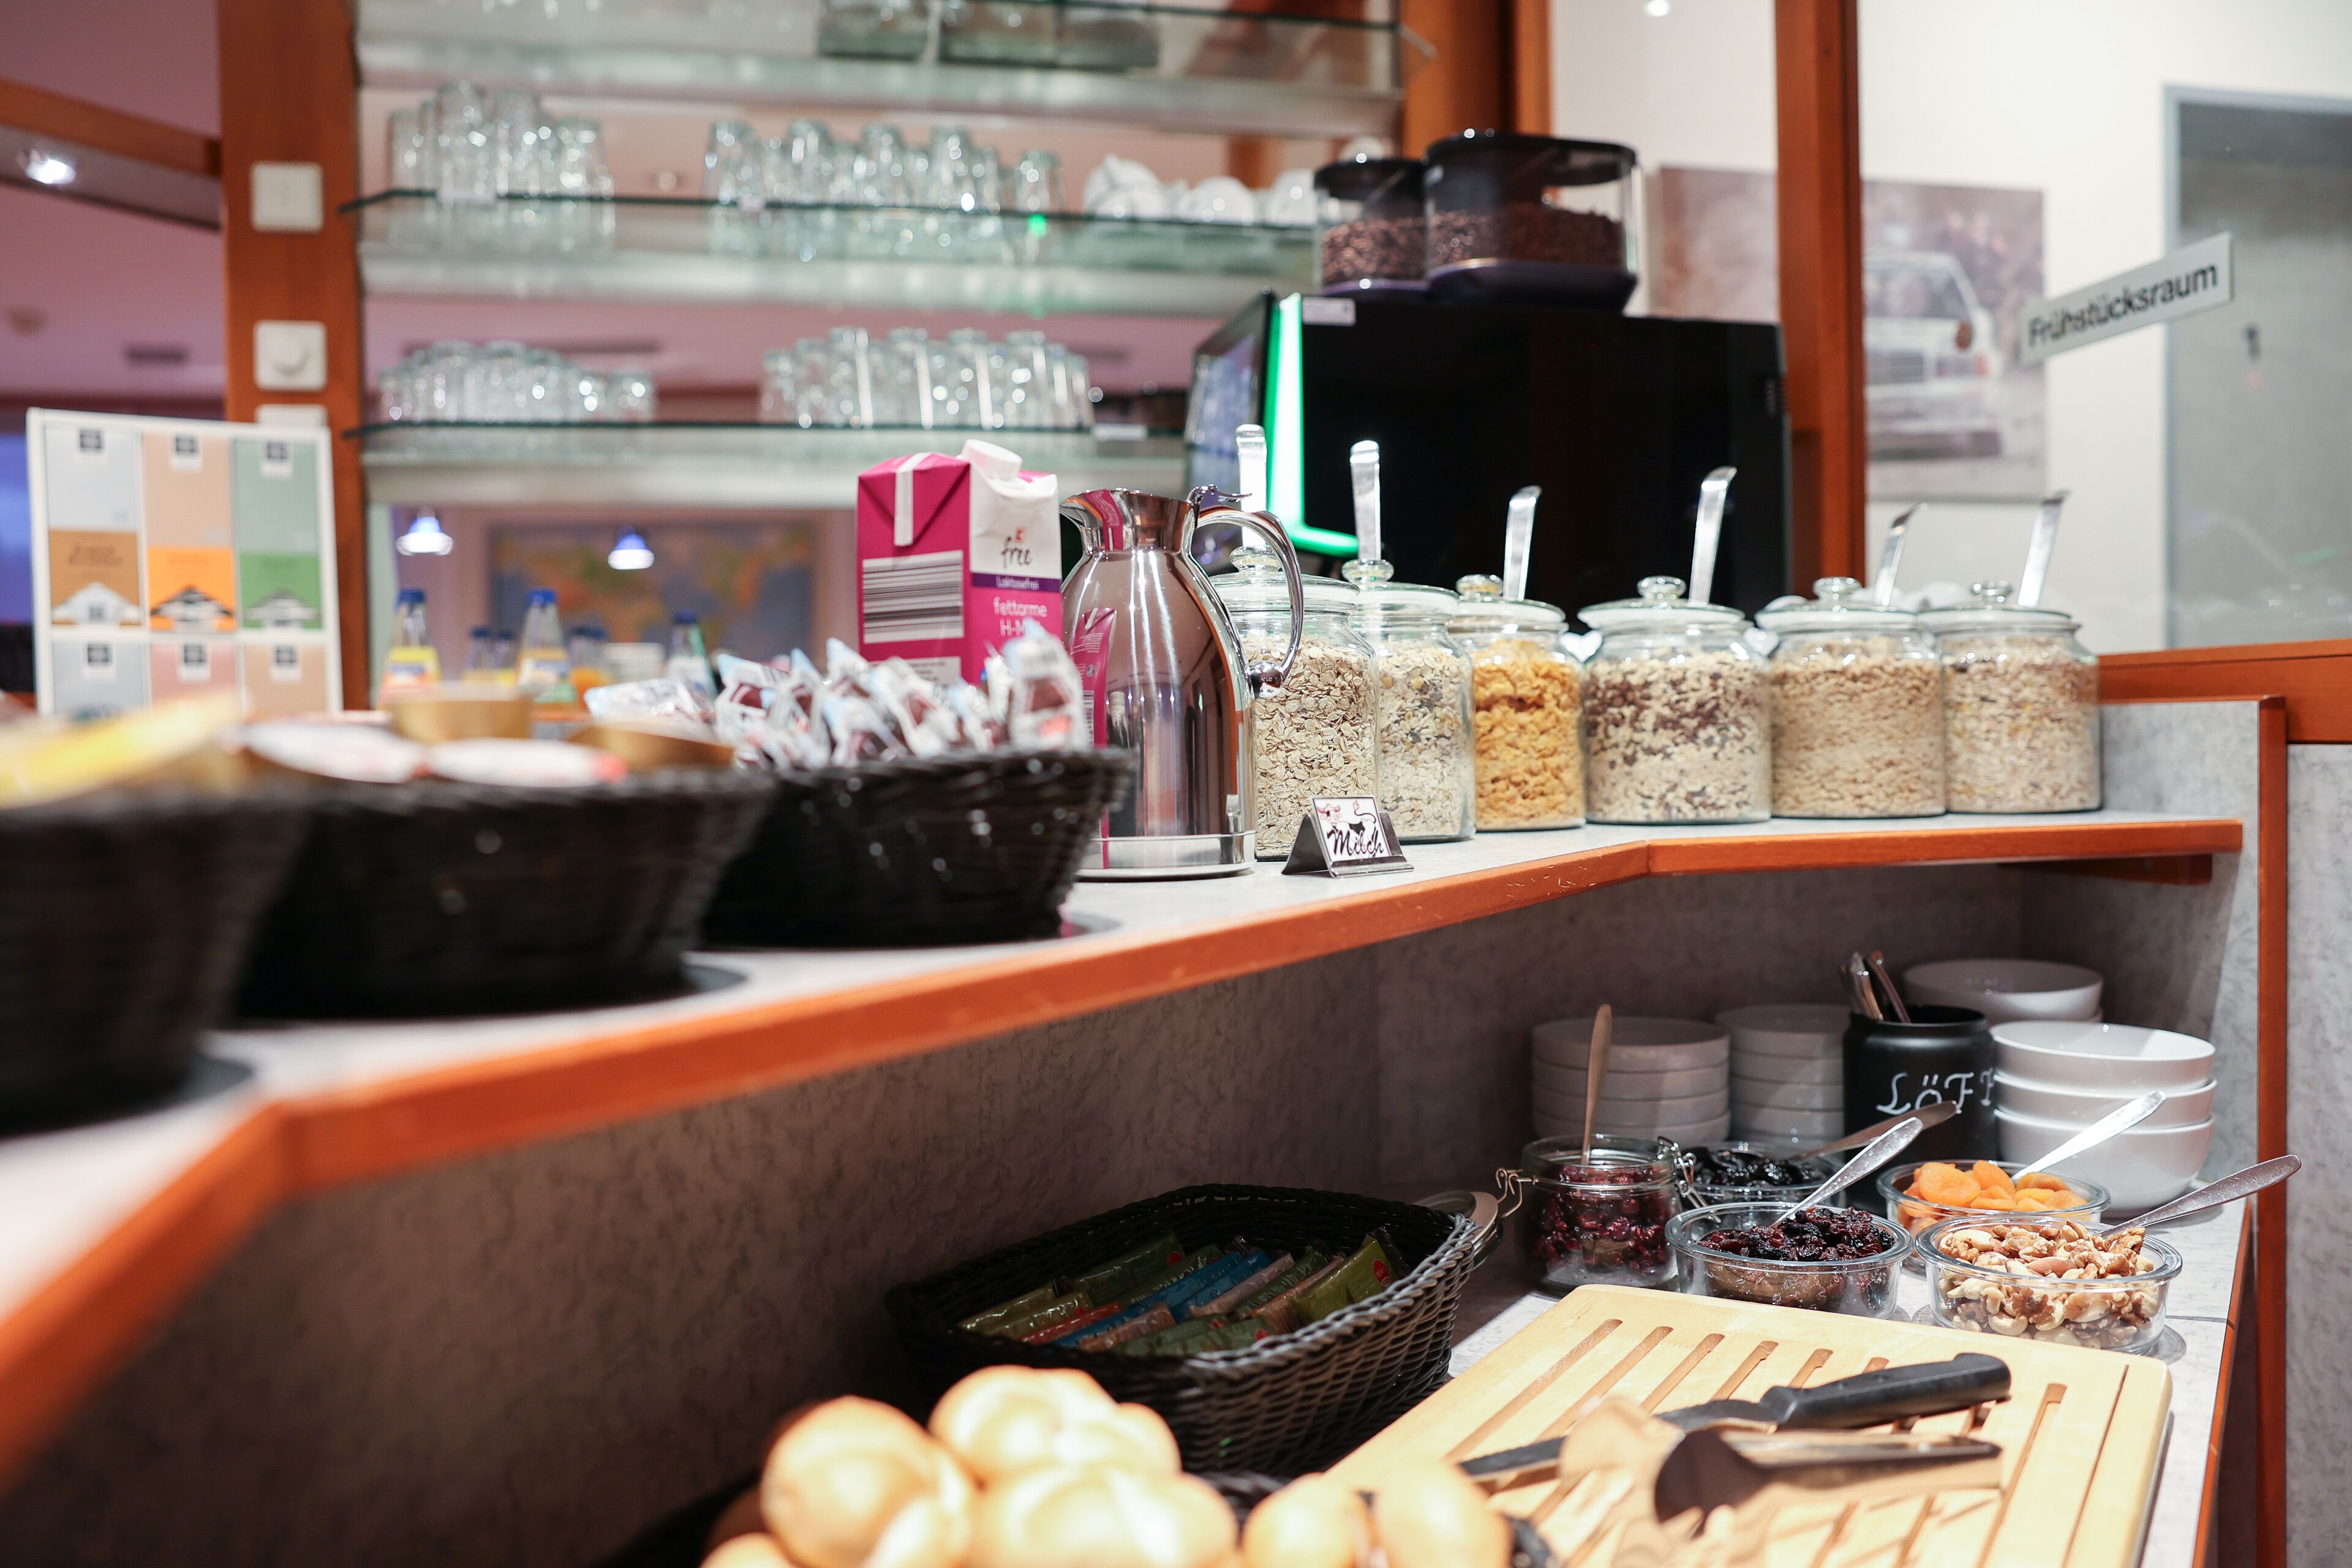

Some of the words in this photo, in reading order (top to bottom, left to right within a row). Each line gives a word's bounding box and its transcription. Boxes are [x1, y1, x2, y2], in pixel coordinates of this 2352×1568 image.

[2028, 263, 2218, 347] Frühstücksraum
[993, 597, 1047, 618] fettarme
[1327, 827, 1384, 857] Milch
